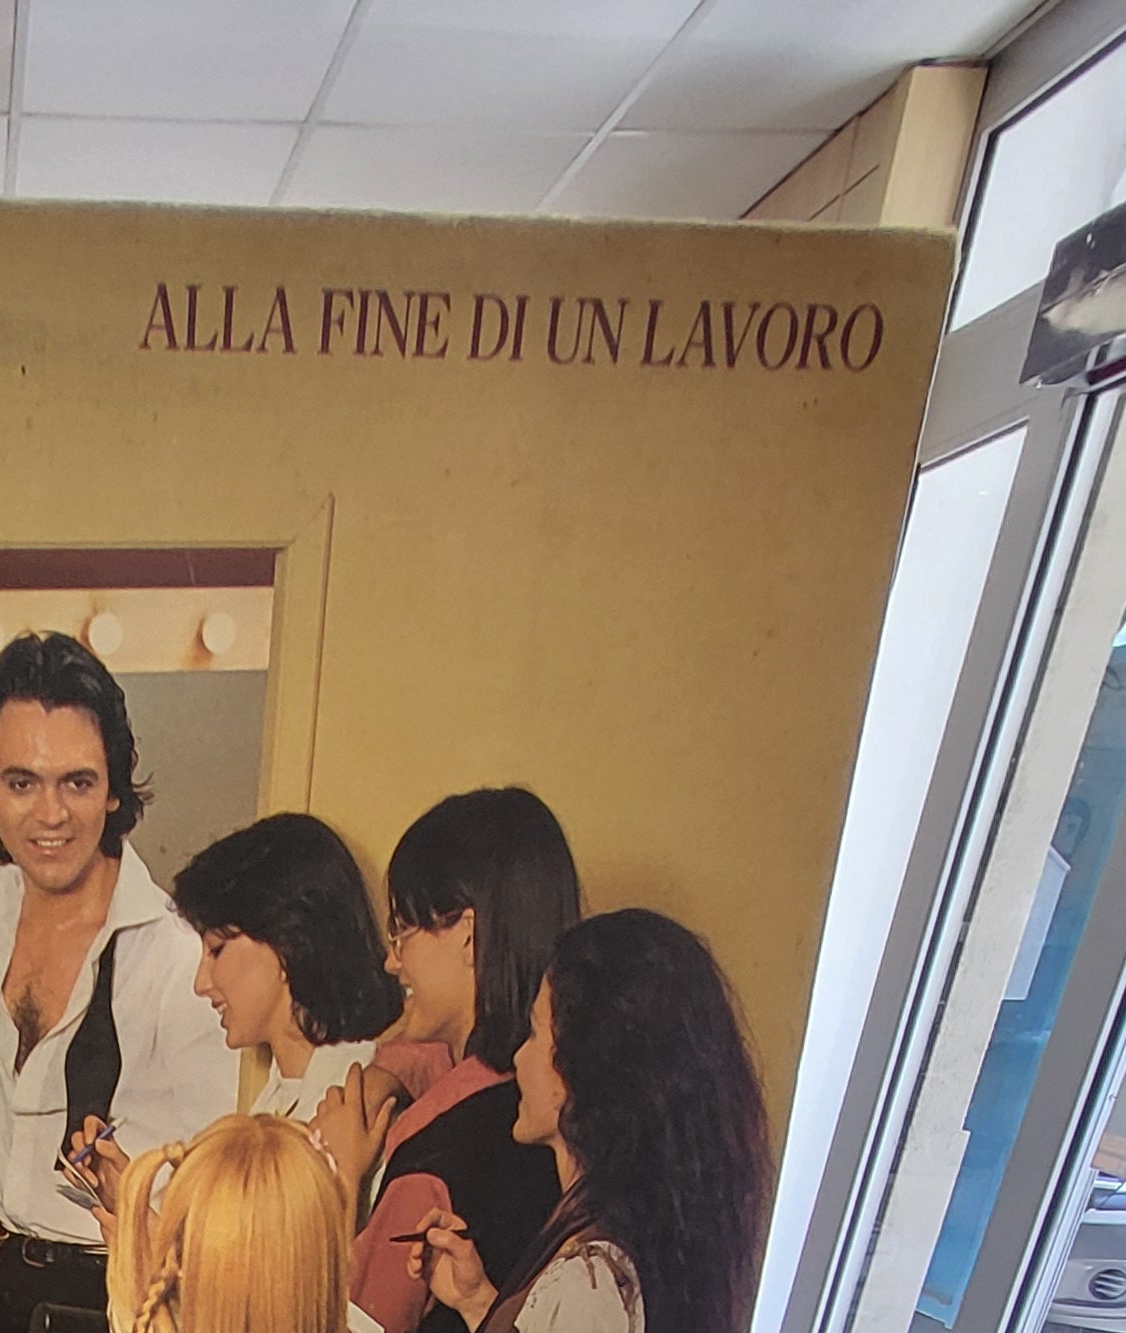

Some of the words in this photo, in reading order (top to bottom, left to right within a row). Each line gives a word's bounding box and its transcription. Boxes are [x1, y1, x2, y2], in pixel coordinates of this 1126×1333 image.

[139, 281, 298, 355] ALLA
[316, 287, 451, 361] FINE
[465, 293, 531, 362] DI
[546, 296, 630, 365] UN
[639, 299, 886, 374] LAVORO
